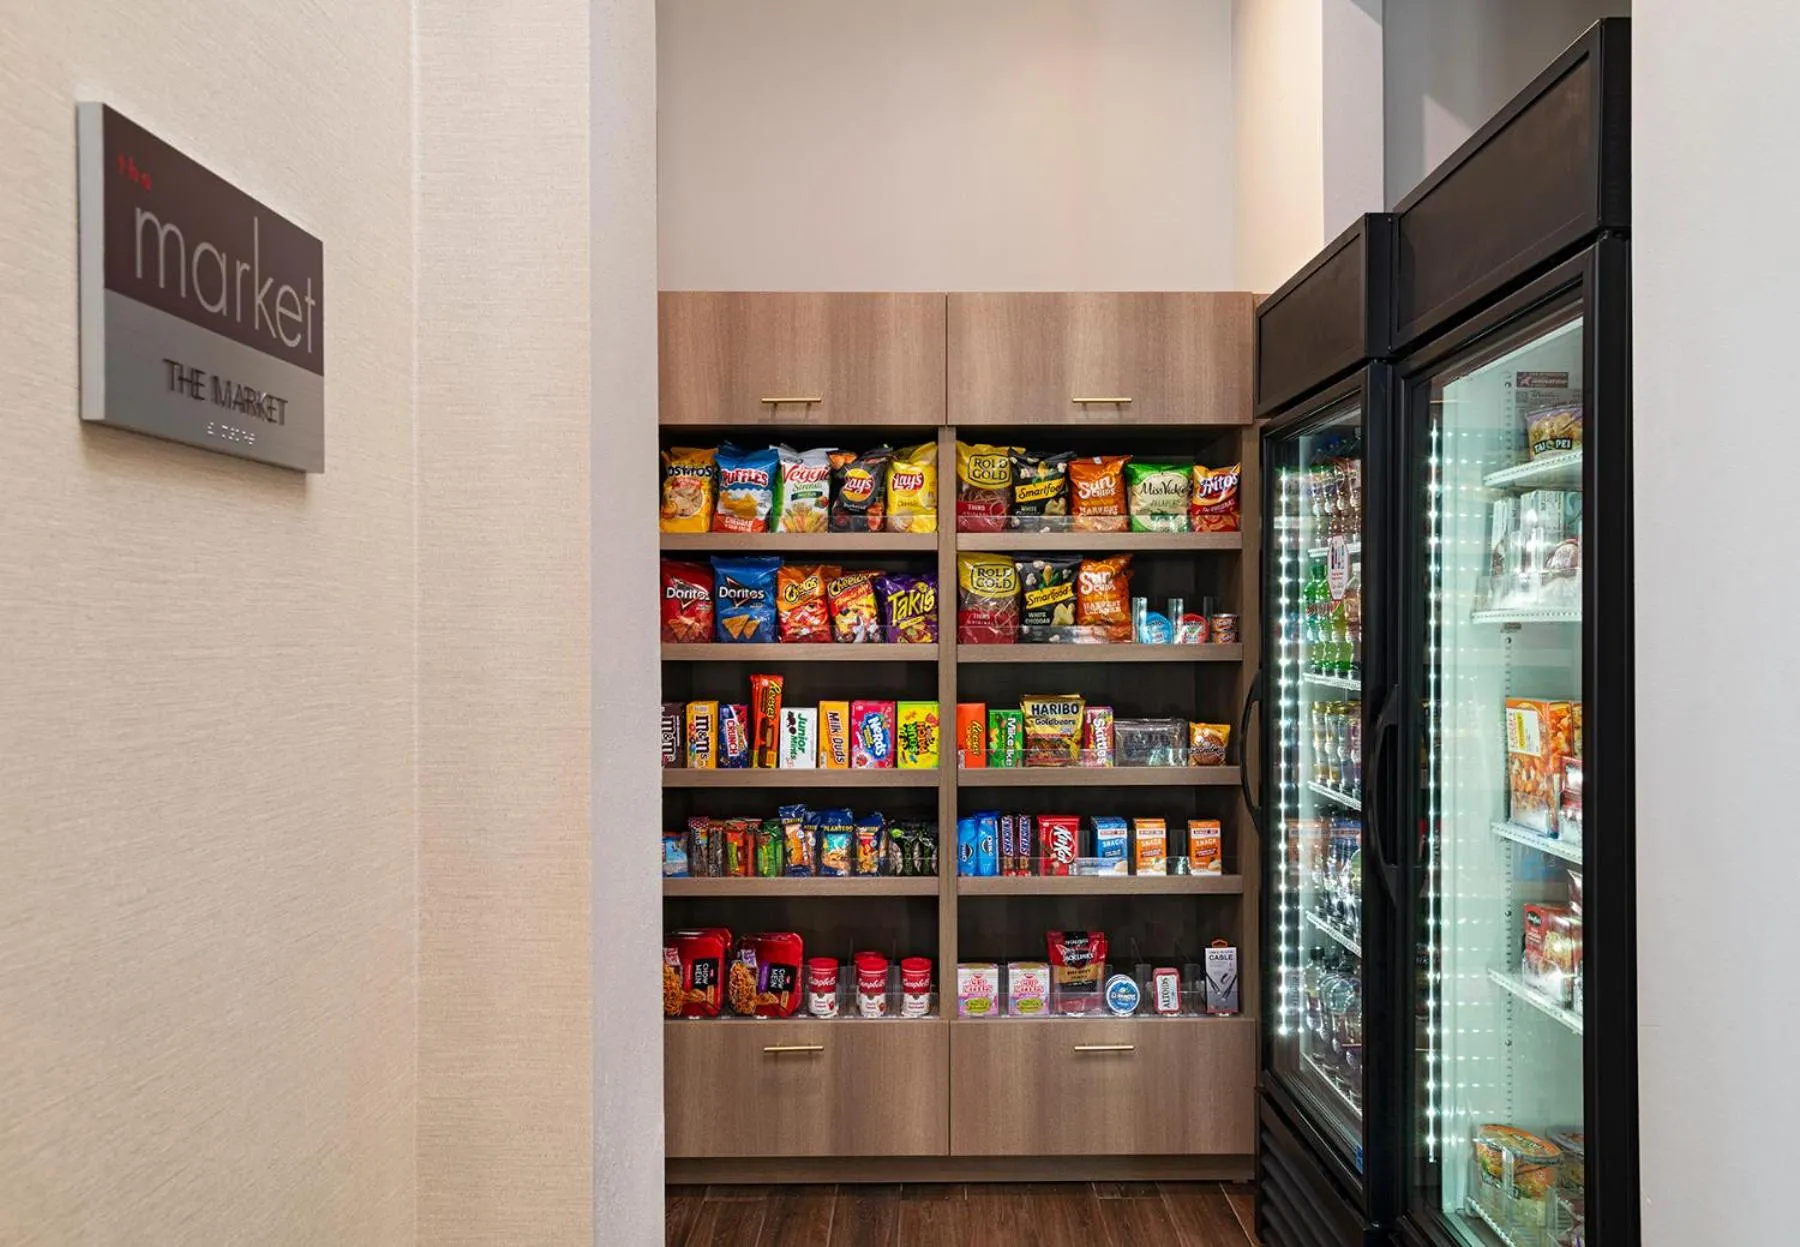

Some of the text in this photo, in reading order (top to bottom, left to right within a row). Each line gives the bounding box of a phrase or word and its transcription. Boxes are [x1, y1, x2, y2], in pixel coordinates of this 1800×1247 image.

[117, 154, 152, 191] the
[135, 206, 316, 353] market
[163, 358, 288, 426] THE MARKET
[891, 471, 924, 490] Lay's
[972, 469, 1008, 480] GOLD
[1199, 473, 1238, 498] Fritos
[1079, 476, 1117, 499] Sun
[666, 587, 711, 601] Doritos
[719, 586, 765, 600] Doritos
[976, 579, 1012, 589] GOLD
[1027, 586, 1069, 605] Smartfood
[888, 586, 936, 627] Takis
[1031, 703, 1081, 716] HARIBO
[726, 719, 739, 756] CRUNCH
[797, 713, 808, 753] Junior
[829, 711, 846, 764] Milk Duds
[908, 724, 917, 754] SOUR
[1007, 717, 1016, 746] Mike
[790, 736, 798, 760] Mints
[1102, 838, 1124, 847] SNACK
[694, 964, 703, 985] MEIN
[702, 962, 710, 985] CHOW
[778, 968, 786, 989] CHOW
[1162, 977, 1170, 1008] ALTOIDS
